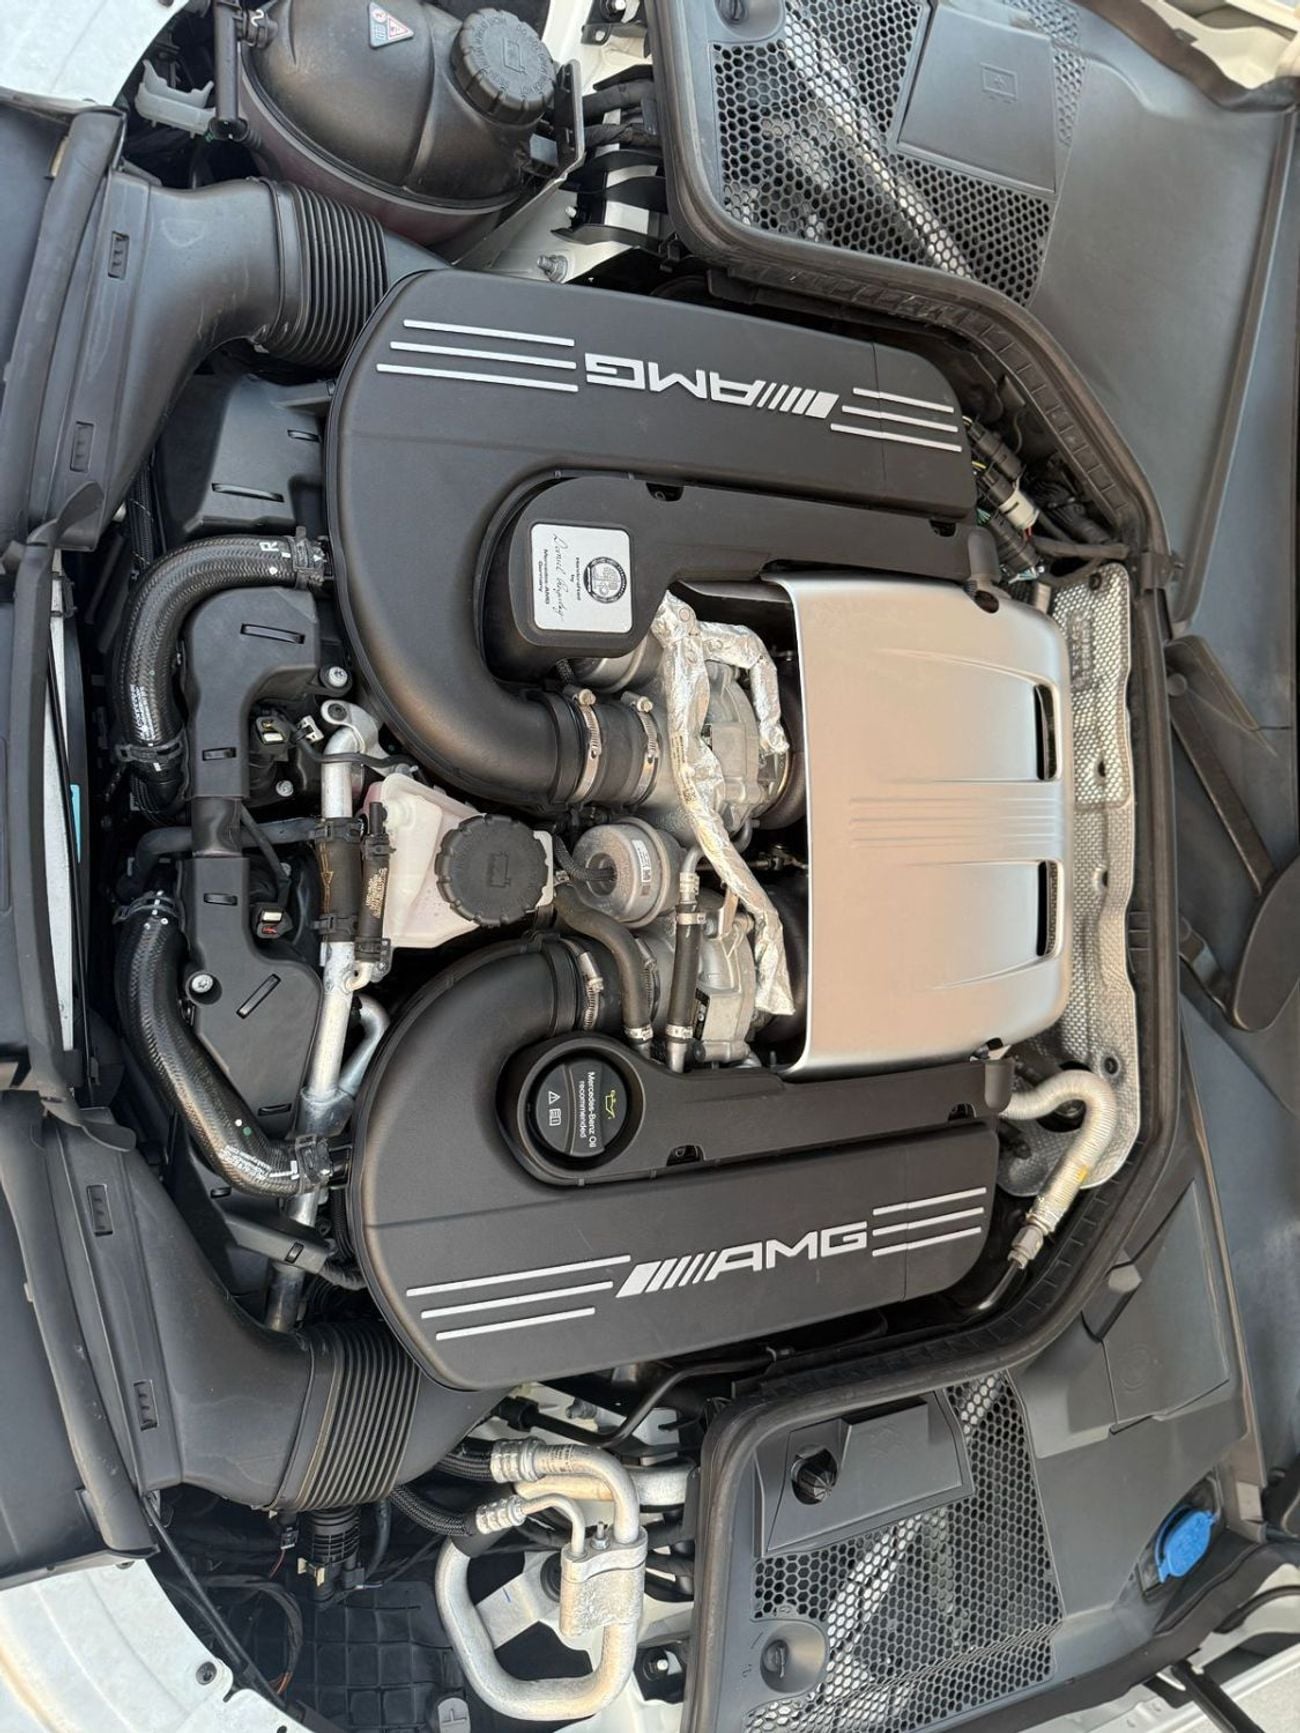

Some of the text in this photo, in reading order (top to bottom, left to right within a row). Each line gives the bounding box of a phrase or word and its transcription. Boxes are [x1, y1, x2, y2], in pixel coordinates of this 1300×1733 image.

[584, 352, 766, 407] AMG
[579, 1080, 587, 1138] recommended
[587, 1071, 597, 1135] Mercedes-Benz
[703, 1220, 868, 1283] AMG
